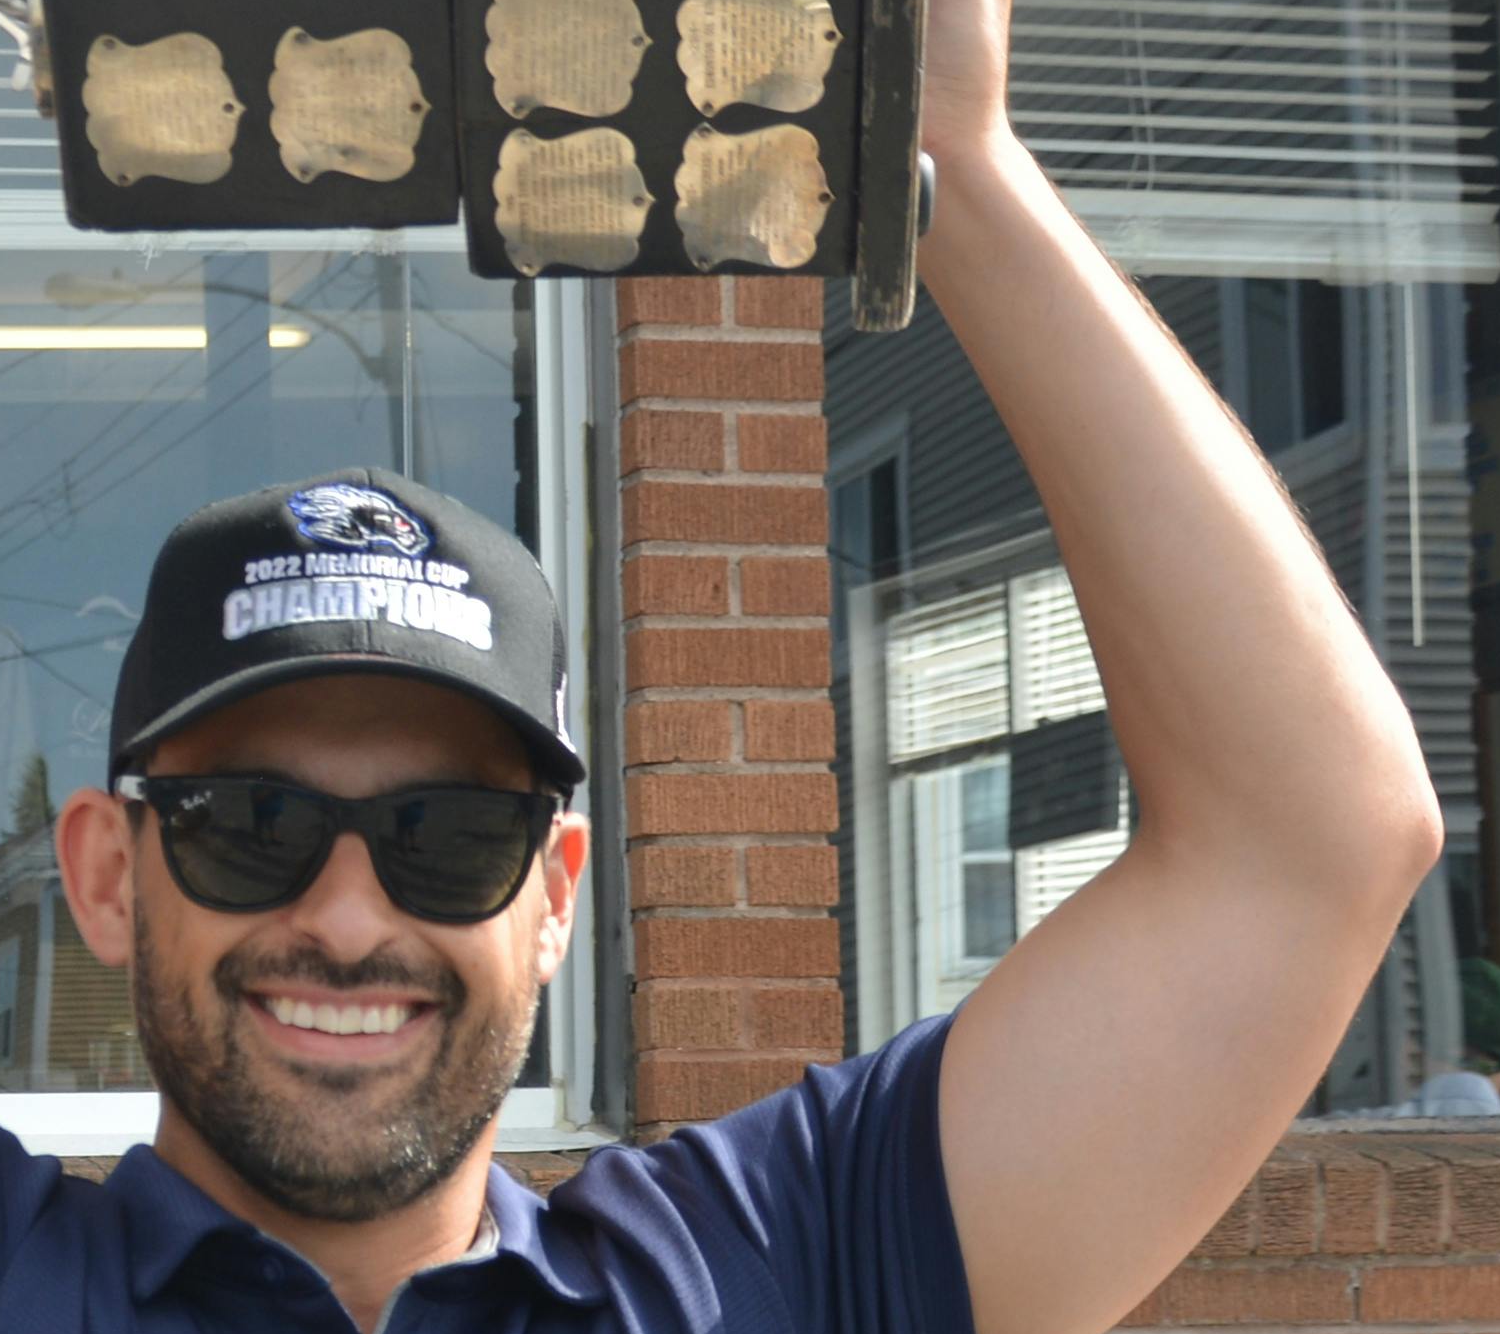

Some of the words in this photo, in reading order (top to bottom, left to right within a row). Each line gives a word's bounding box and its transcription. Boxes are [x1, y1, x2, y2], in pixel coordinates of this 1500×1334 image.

[245, 555, 302, 584] 2022
[426, 561, 470, 589] CUP
[222, 576, 493, 651] CHAMPIONS
